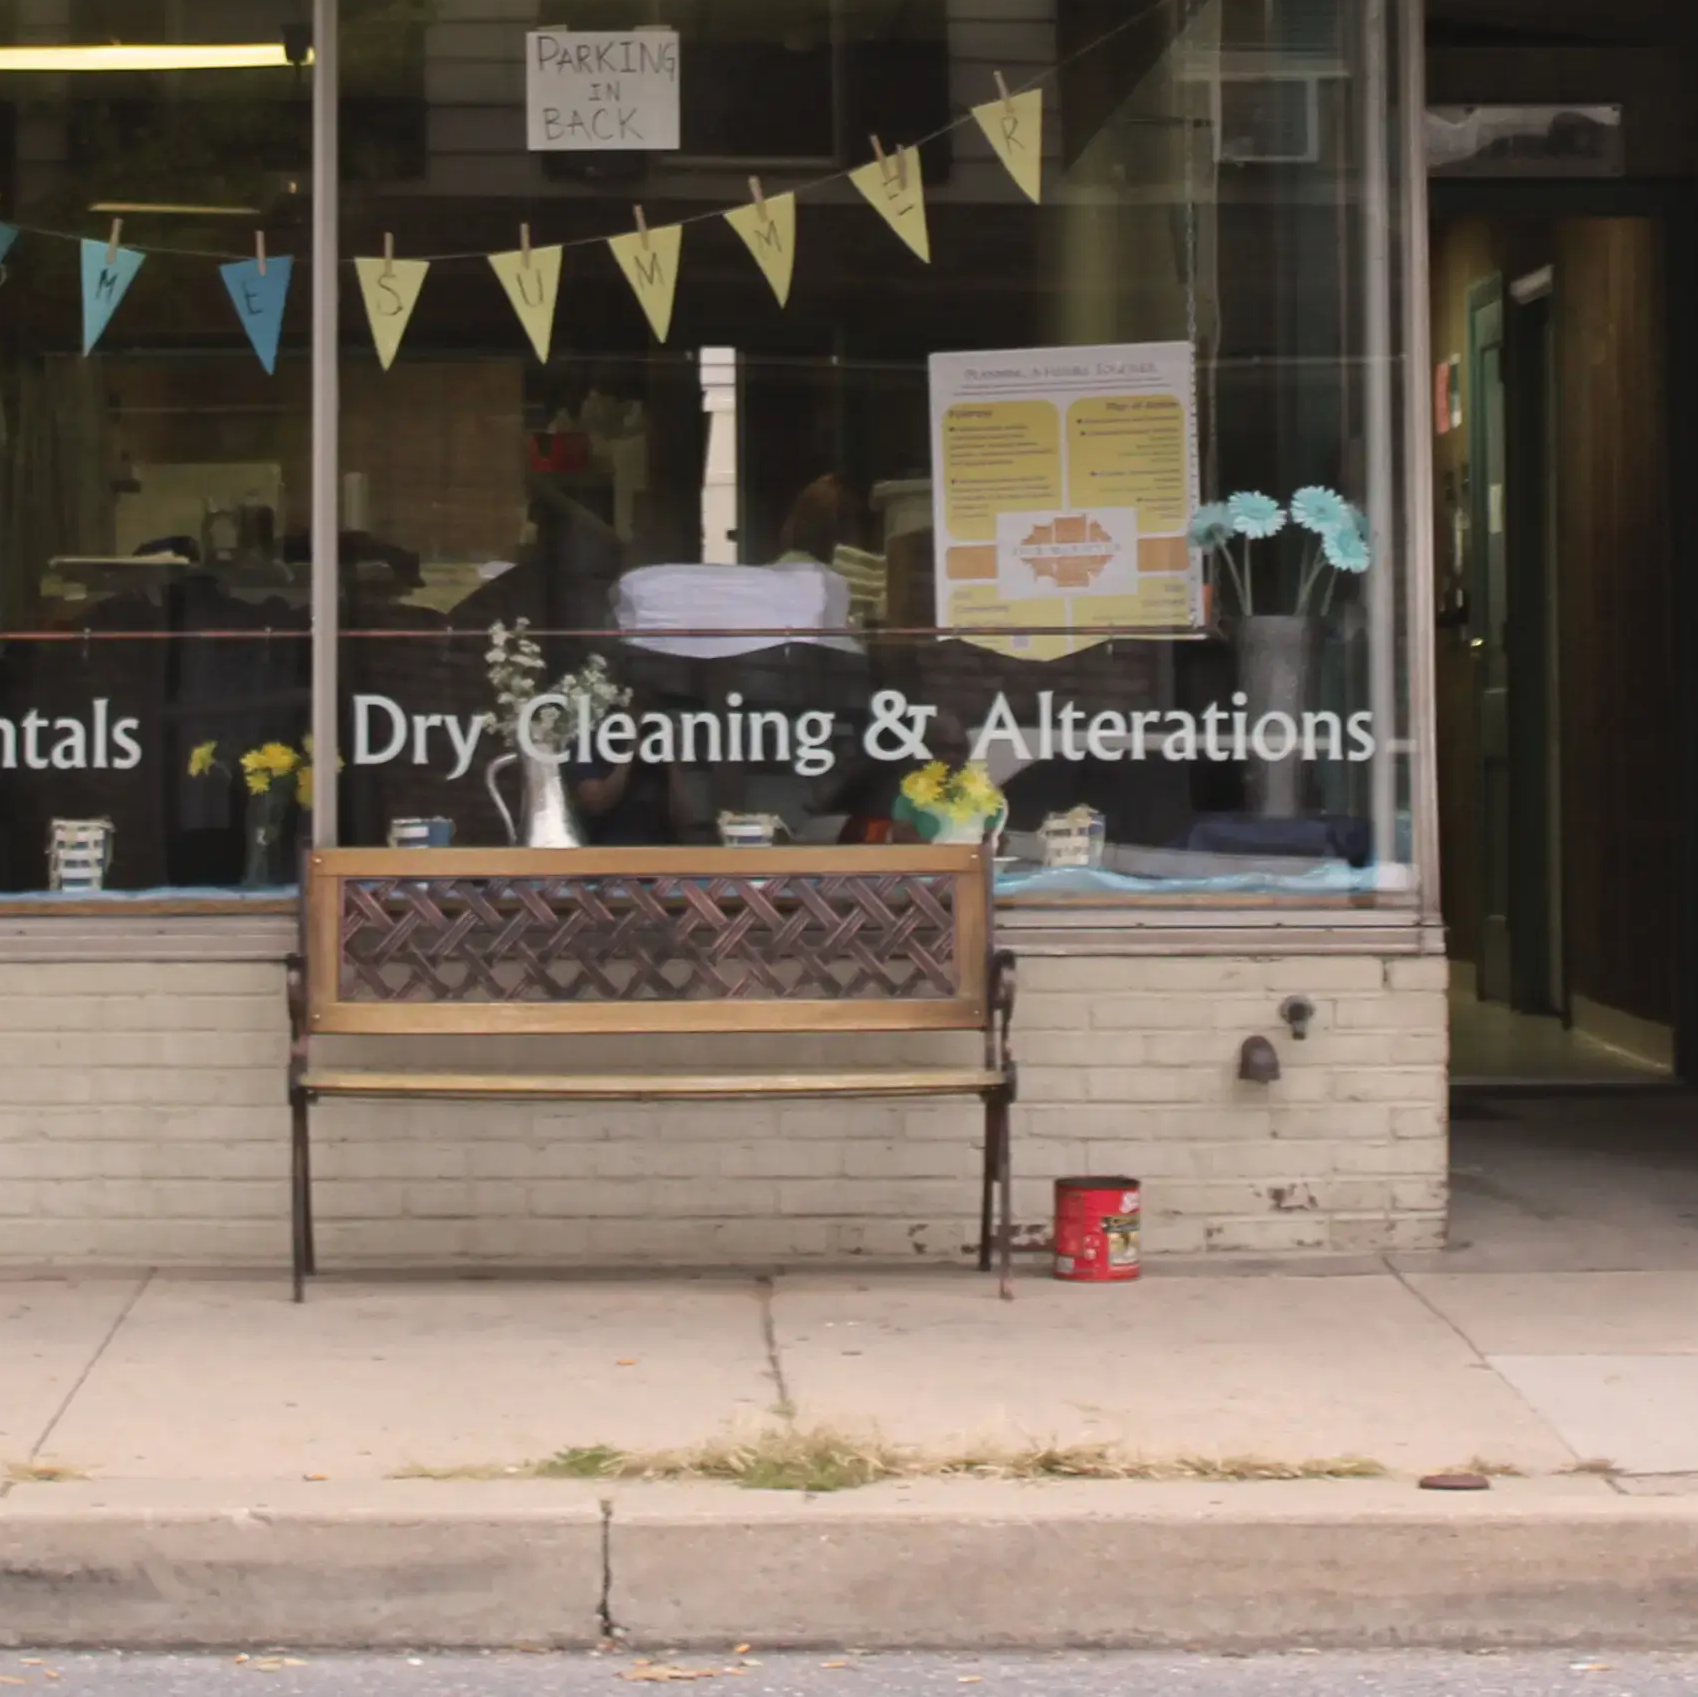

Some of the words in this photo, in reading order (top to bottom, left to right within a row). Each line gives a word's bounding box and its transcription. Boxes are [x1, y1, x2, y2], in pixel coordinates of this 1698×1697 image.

[537, 35, 677, 82] PARKING
[588, 81, 620, 102] IN
[543, 106, 644, 141] BACK
[352, 693, 486, 780] Dry
[516, 692, 835, 777] Cleaning
[862, 689, 938, 762] &
[968, 690, 1377, 762] Alterations
